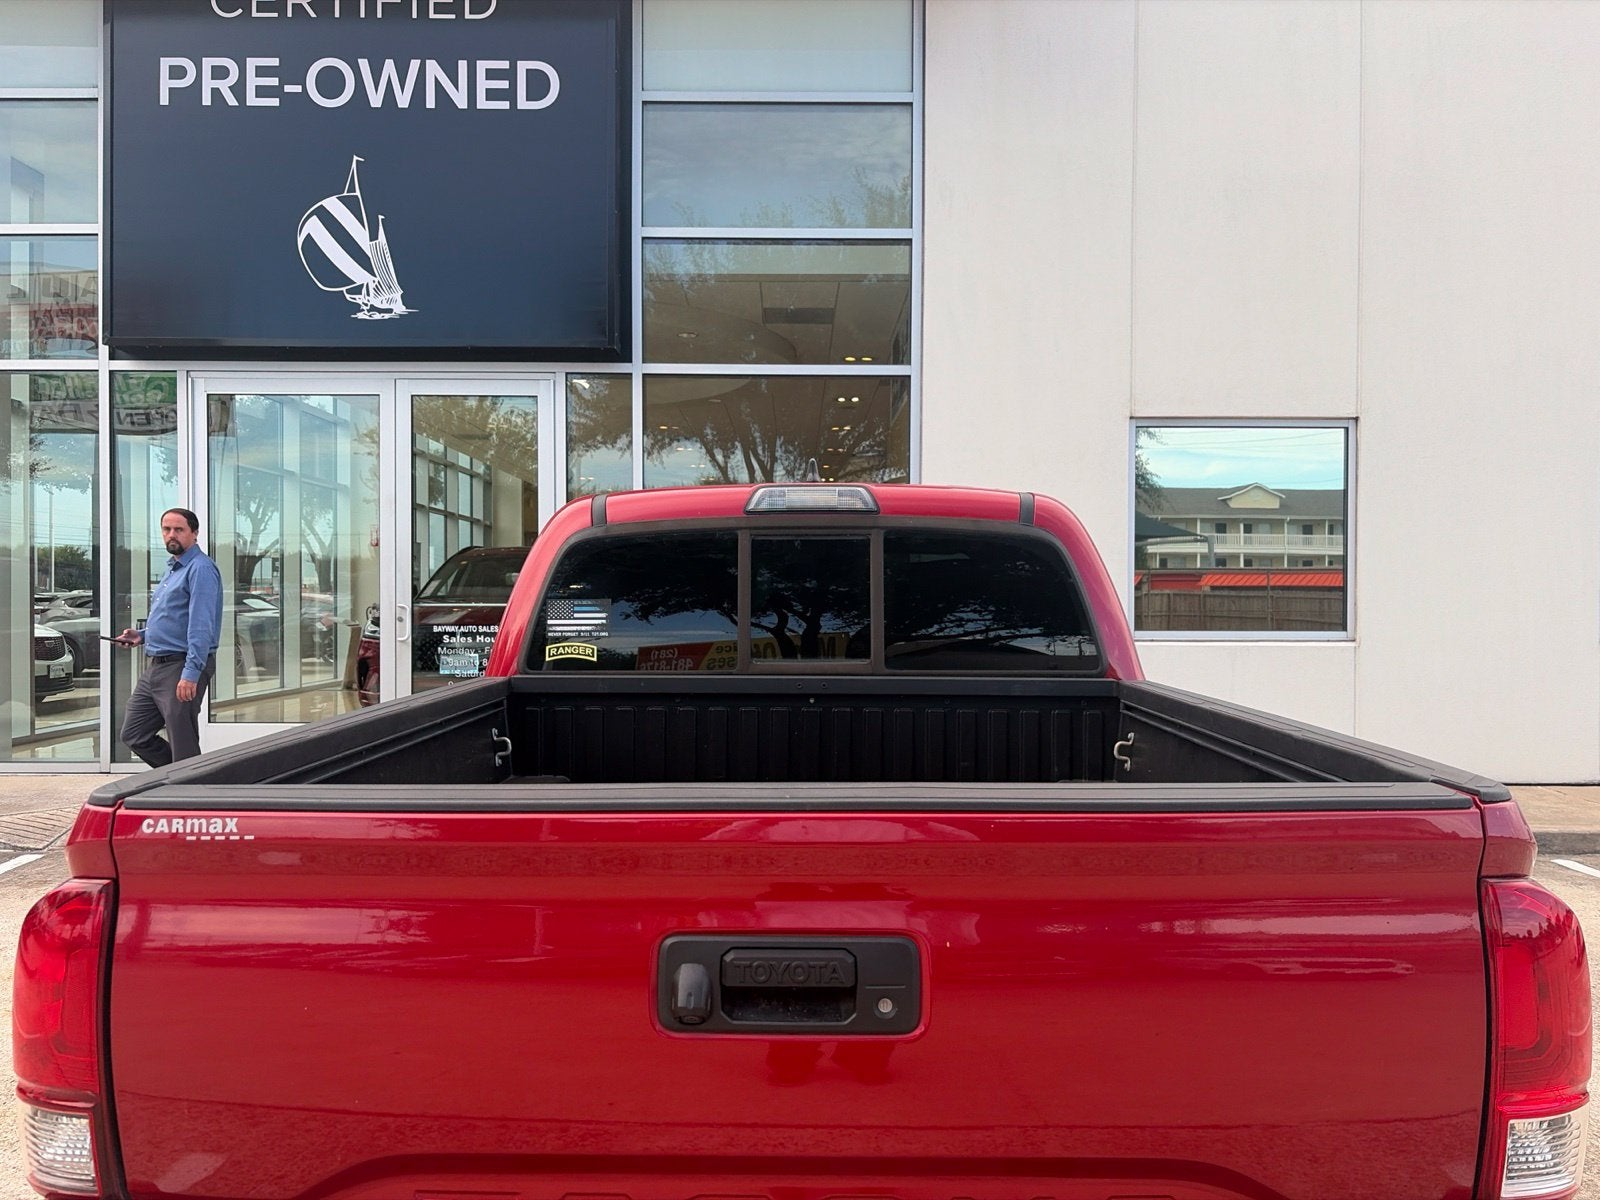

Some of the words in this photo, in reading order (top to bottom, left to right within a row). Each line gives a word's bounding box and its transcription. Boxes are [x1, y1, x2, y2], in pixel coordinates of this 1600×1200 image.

[159, 57, 561, 110] PRE-OWNED
[433, 625, 459, 633] BAYWAY
[459, 625, 477, 633] AUTO
[478, 625, 499, 633] SALES
[442, 634, 472, 643] Sales
[476, 634, 495, 643] Hou
[438, 646, 475, 656] Monday
[550, 646, 593, 657] RANGER
[455, 669, 486, 678] Saturd
[733, 961, 846, 985] TOYOTA
